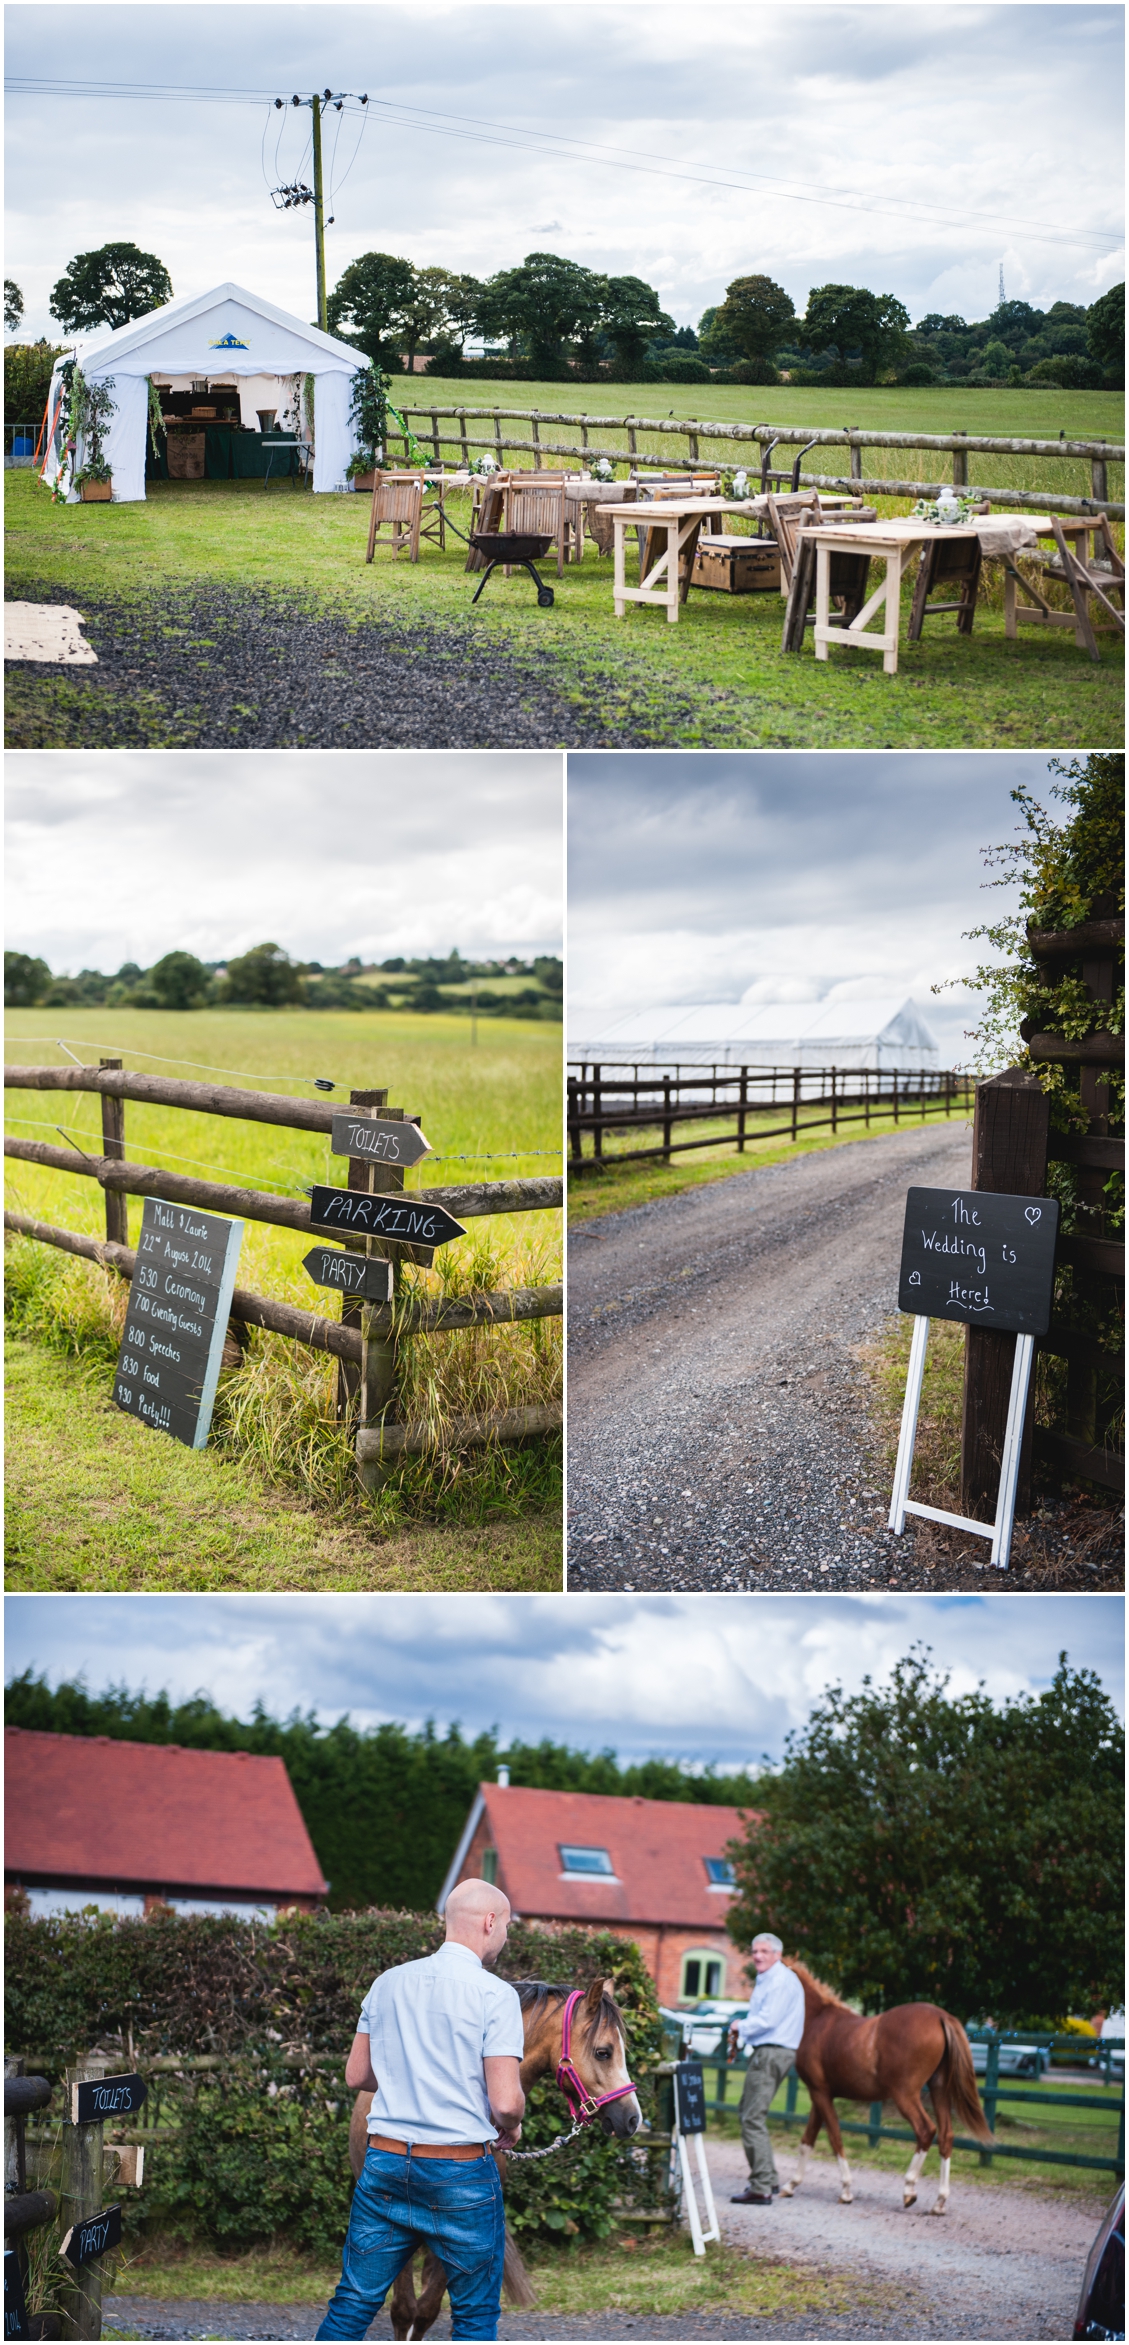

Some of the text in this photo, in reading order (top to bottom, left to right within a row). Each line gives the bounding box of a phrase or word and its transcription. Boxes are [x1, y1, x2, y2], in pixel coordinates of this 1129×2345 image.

[348, 1124, 400, 1160] TOILETS
[153, 1204, 175, 1229] Matt
[184, 1216, 208, 1240] Laurie
[323, 1196, 446, 1238] PARKING
[951, 1197, 982, 1226] The
[164, 1241, 190, 1268] August
[191, 1250, 212, 1276] 2014
[921, 1229, 1017, 1274] Wedding is
[321, 1253, 366, 1289] PARTY
[949, 1280, 989, 1304] Here!
[151, 1301, 177, 1331] Evening
[178, 1314, 202, 1337] Guests
[149, 1335, 180, 1362] Speeches
[92, 2086, 132, 2109] TOILETS
[80, 2220, 110, 2262] PARTY
